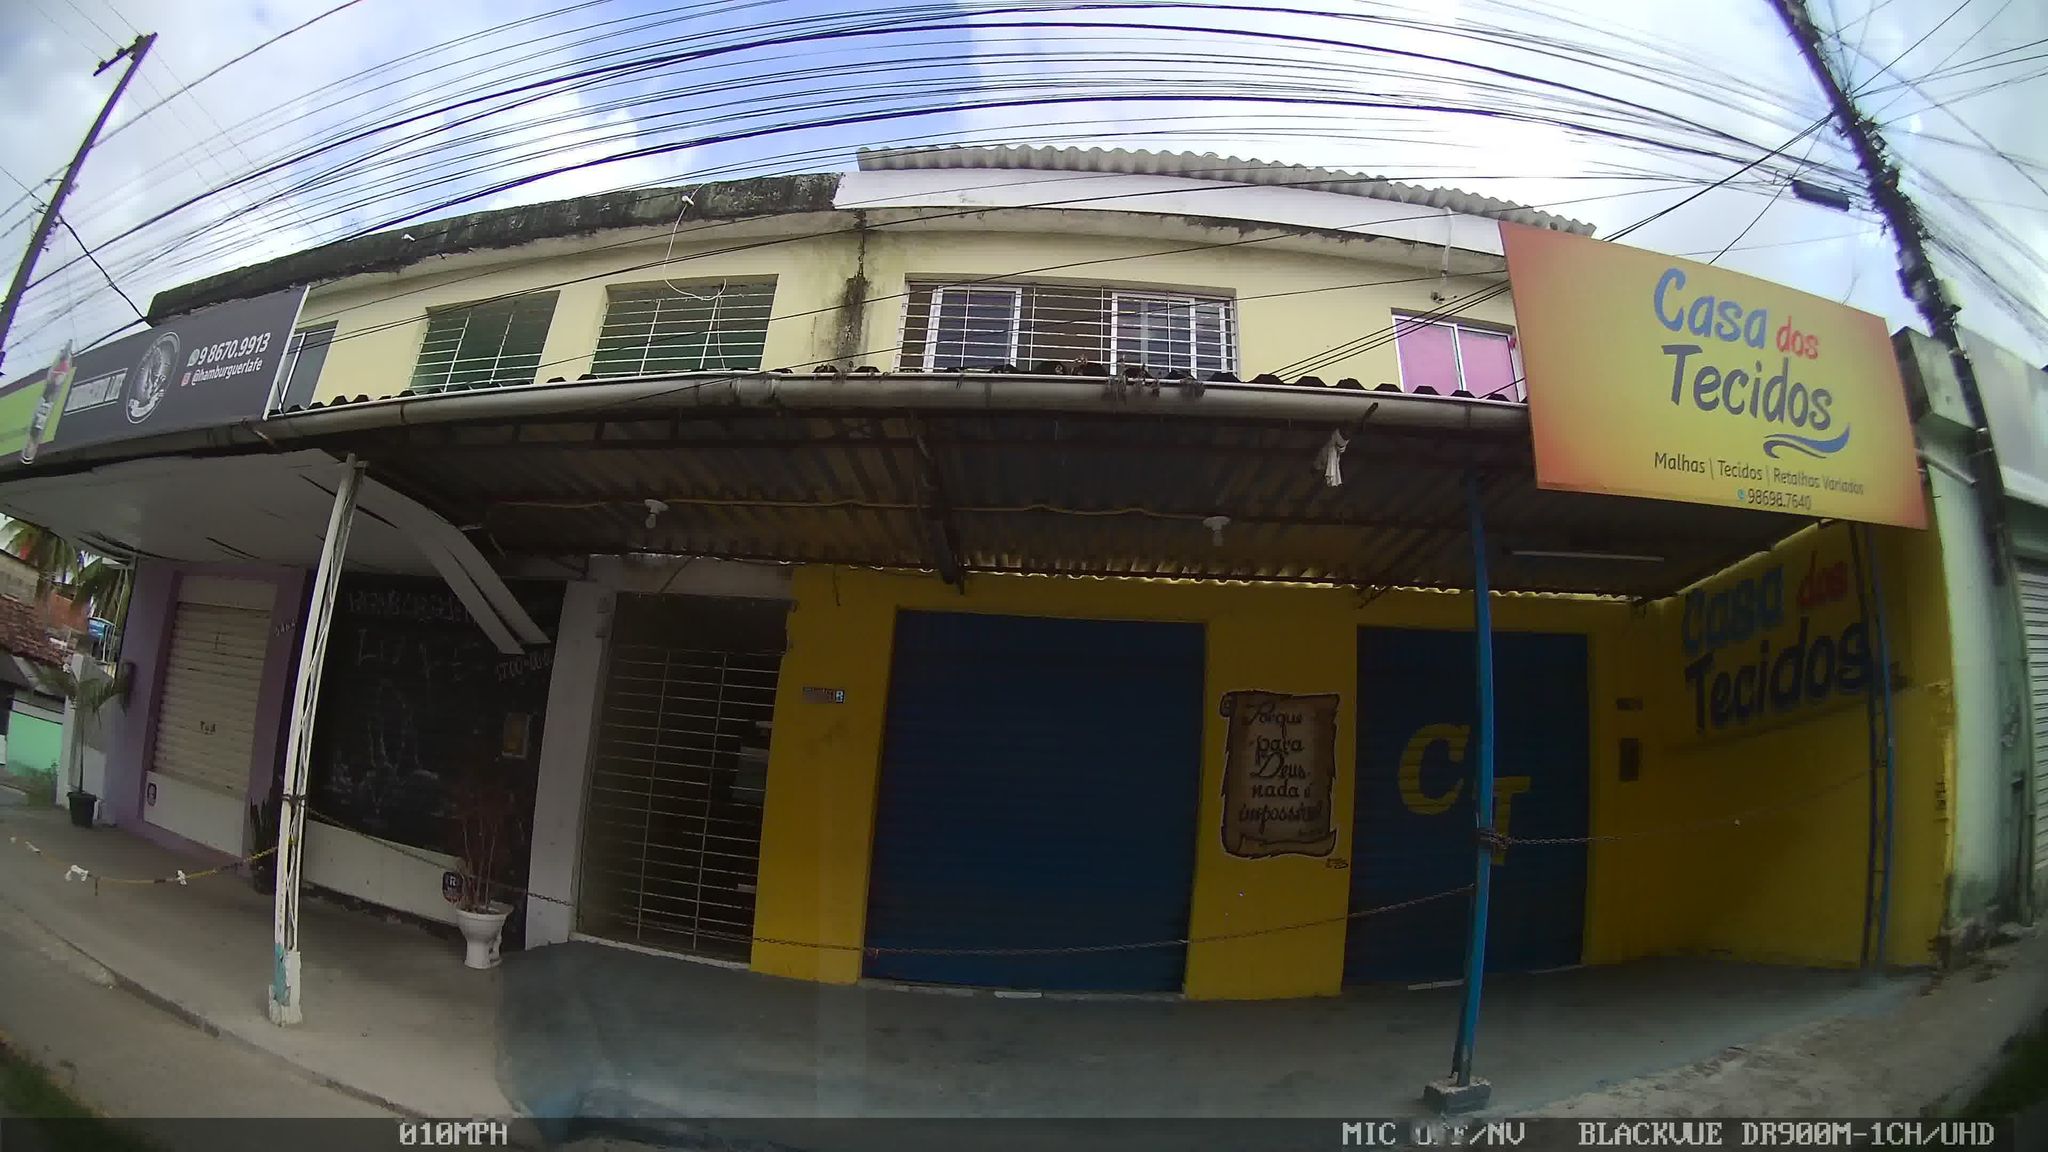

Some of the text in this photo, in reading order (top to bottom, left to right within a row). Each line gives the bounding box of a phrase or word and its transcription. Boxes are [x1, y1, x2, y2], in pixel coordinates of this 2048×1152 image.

[1654, 267, 1819, 360] Casa dos
[207, 332, 271, 363] 8670.9913
[1661, 344, 1833, 430] Tecidos
[1654, 452, 1706, 474] Malhas
[1718, 460, 1763, 481] Tecidos
[1747, 488, 1812, 511] 98698.7640
[1684, 563, 1785, 656] Casa
[1685, 615, 1875, 735] Tecidos
[1256, 735, 1304, 764] para
[1252, 778, 1299, 798] nada
